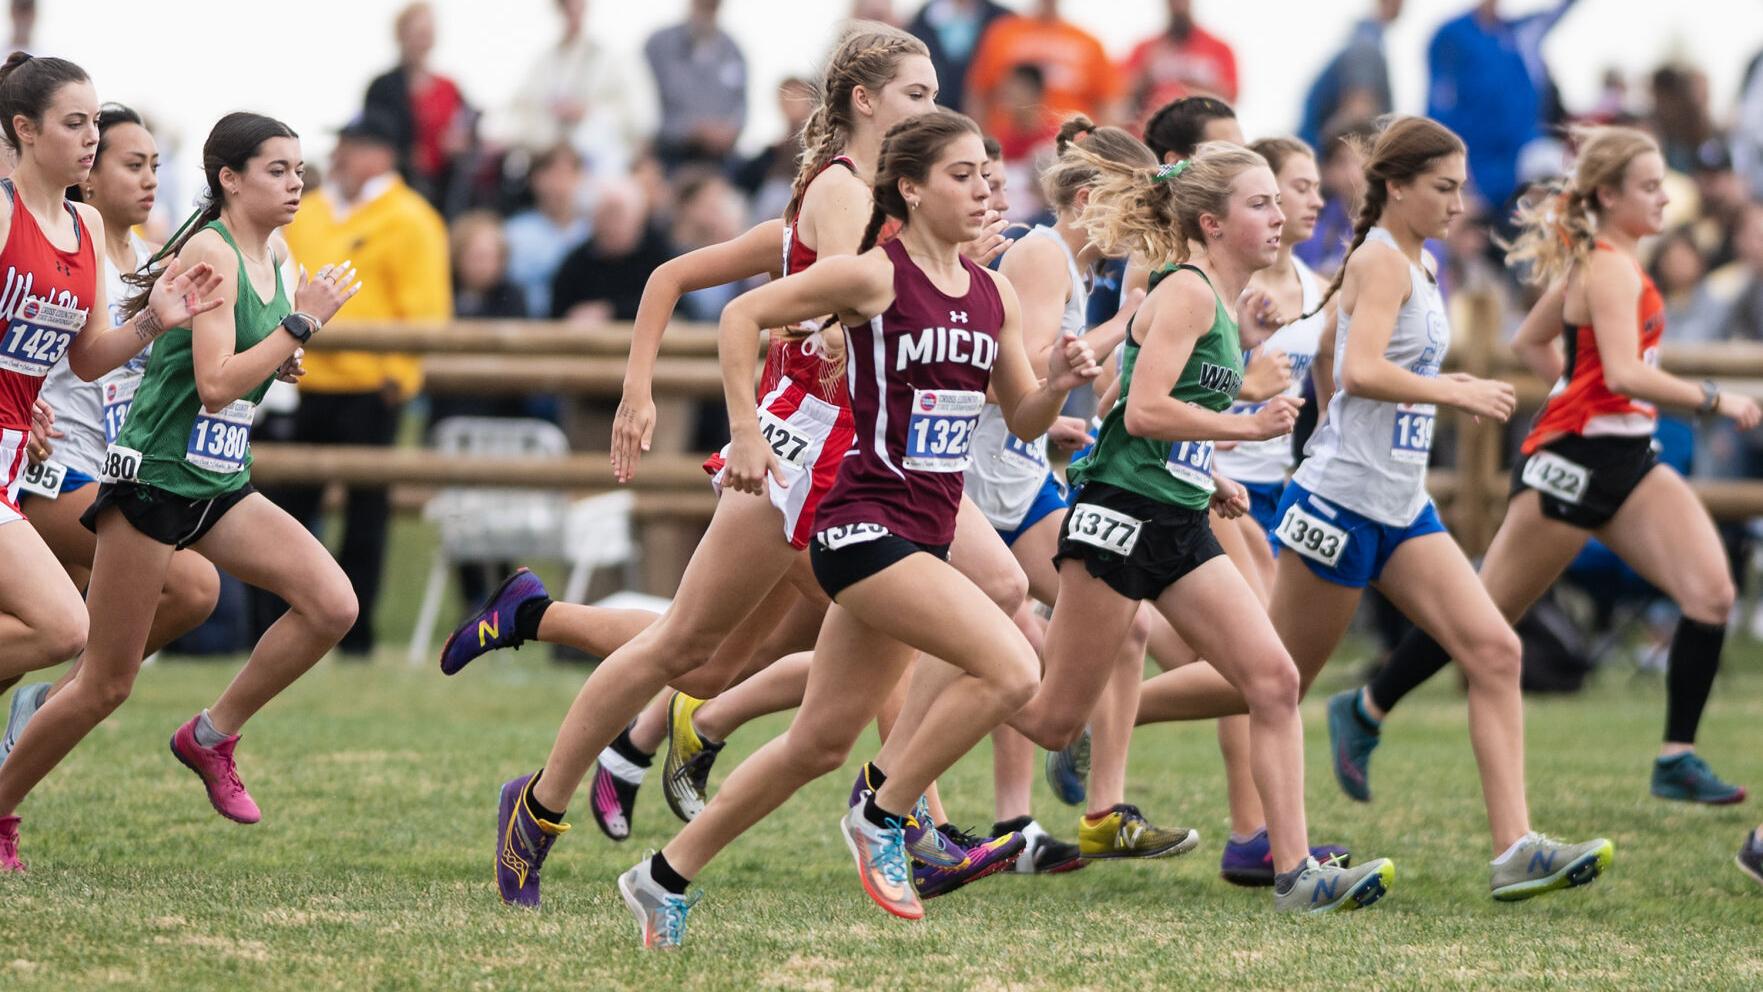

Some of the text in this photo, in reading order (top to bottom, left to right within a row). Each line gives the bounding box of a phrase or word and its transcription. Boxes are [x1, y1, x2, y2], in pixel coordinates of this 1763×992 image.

[7, 324, 71, 363] 1423
[896, 327, 999, 371] MICD
[106, 404, 132, 443] 13
[196, 419, 248, 459] 1380
[759, 416, 808, 461] 427
[1178, 440, 1214, 473] 137
[1075, 510, 1135, 548] 1377
[1283, 512, 1341, 559] 1393
